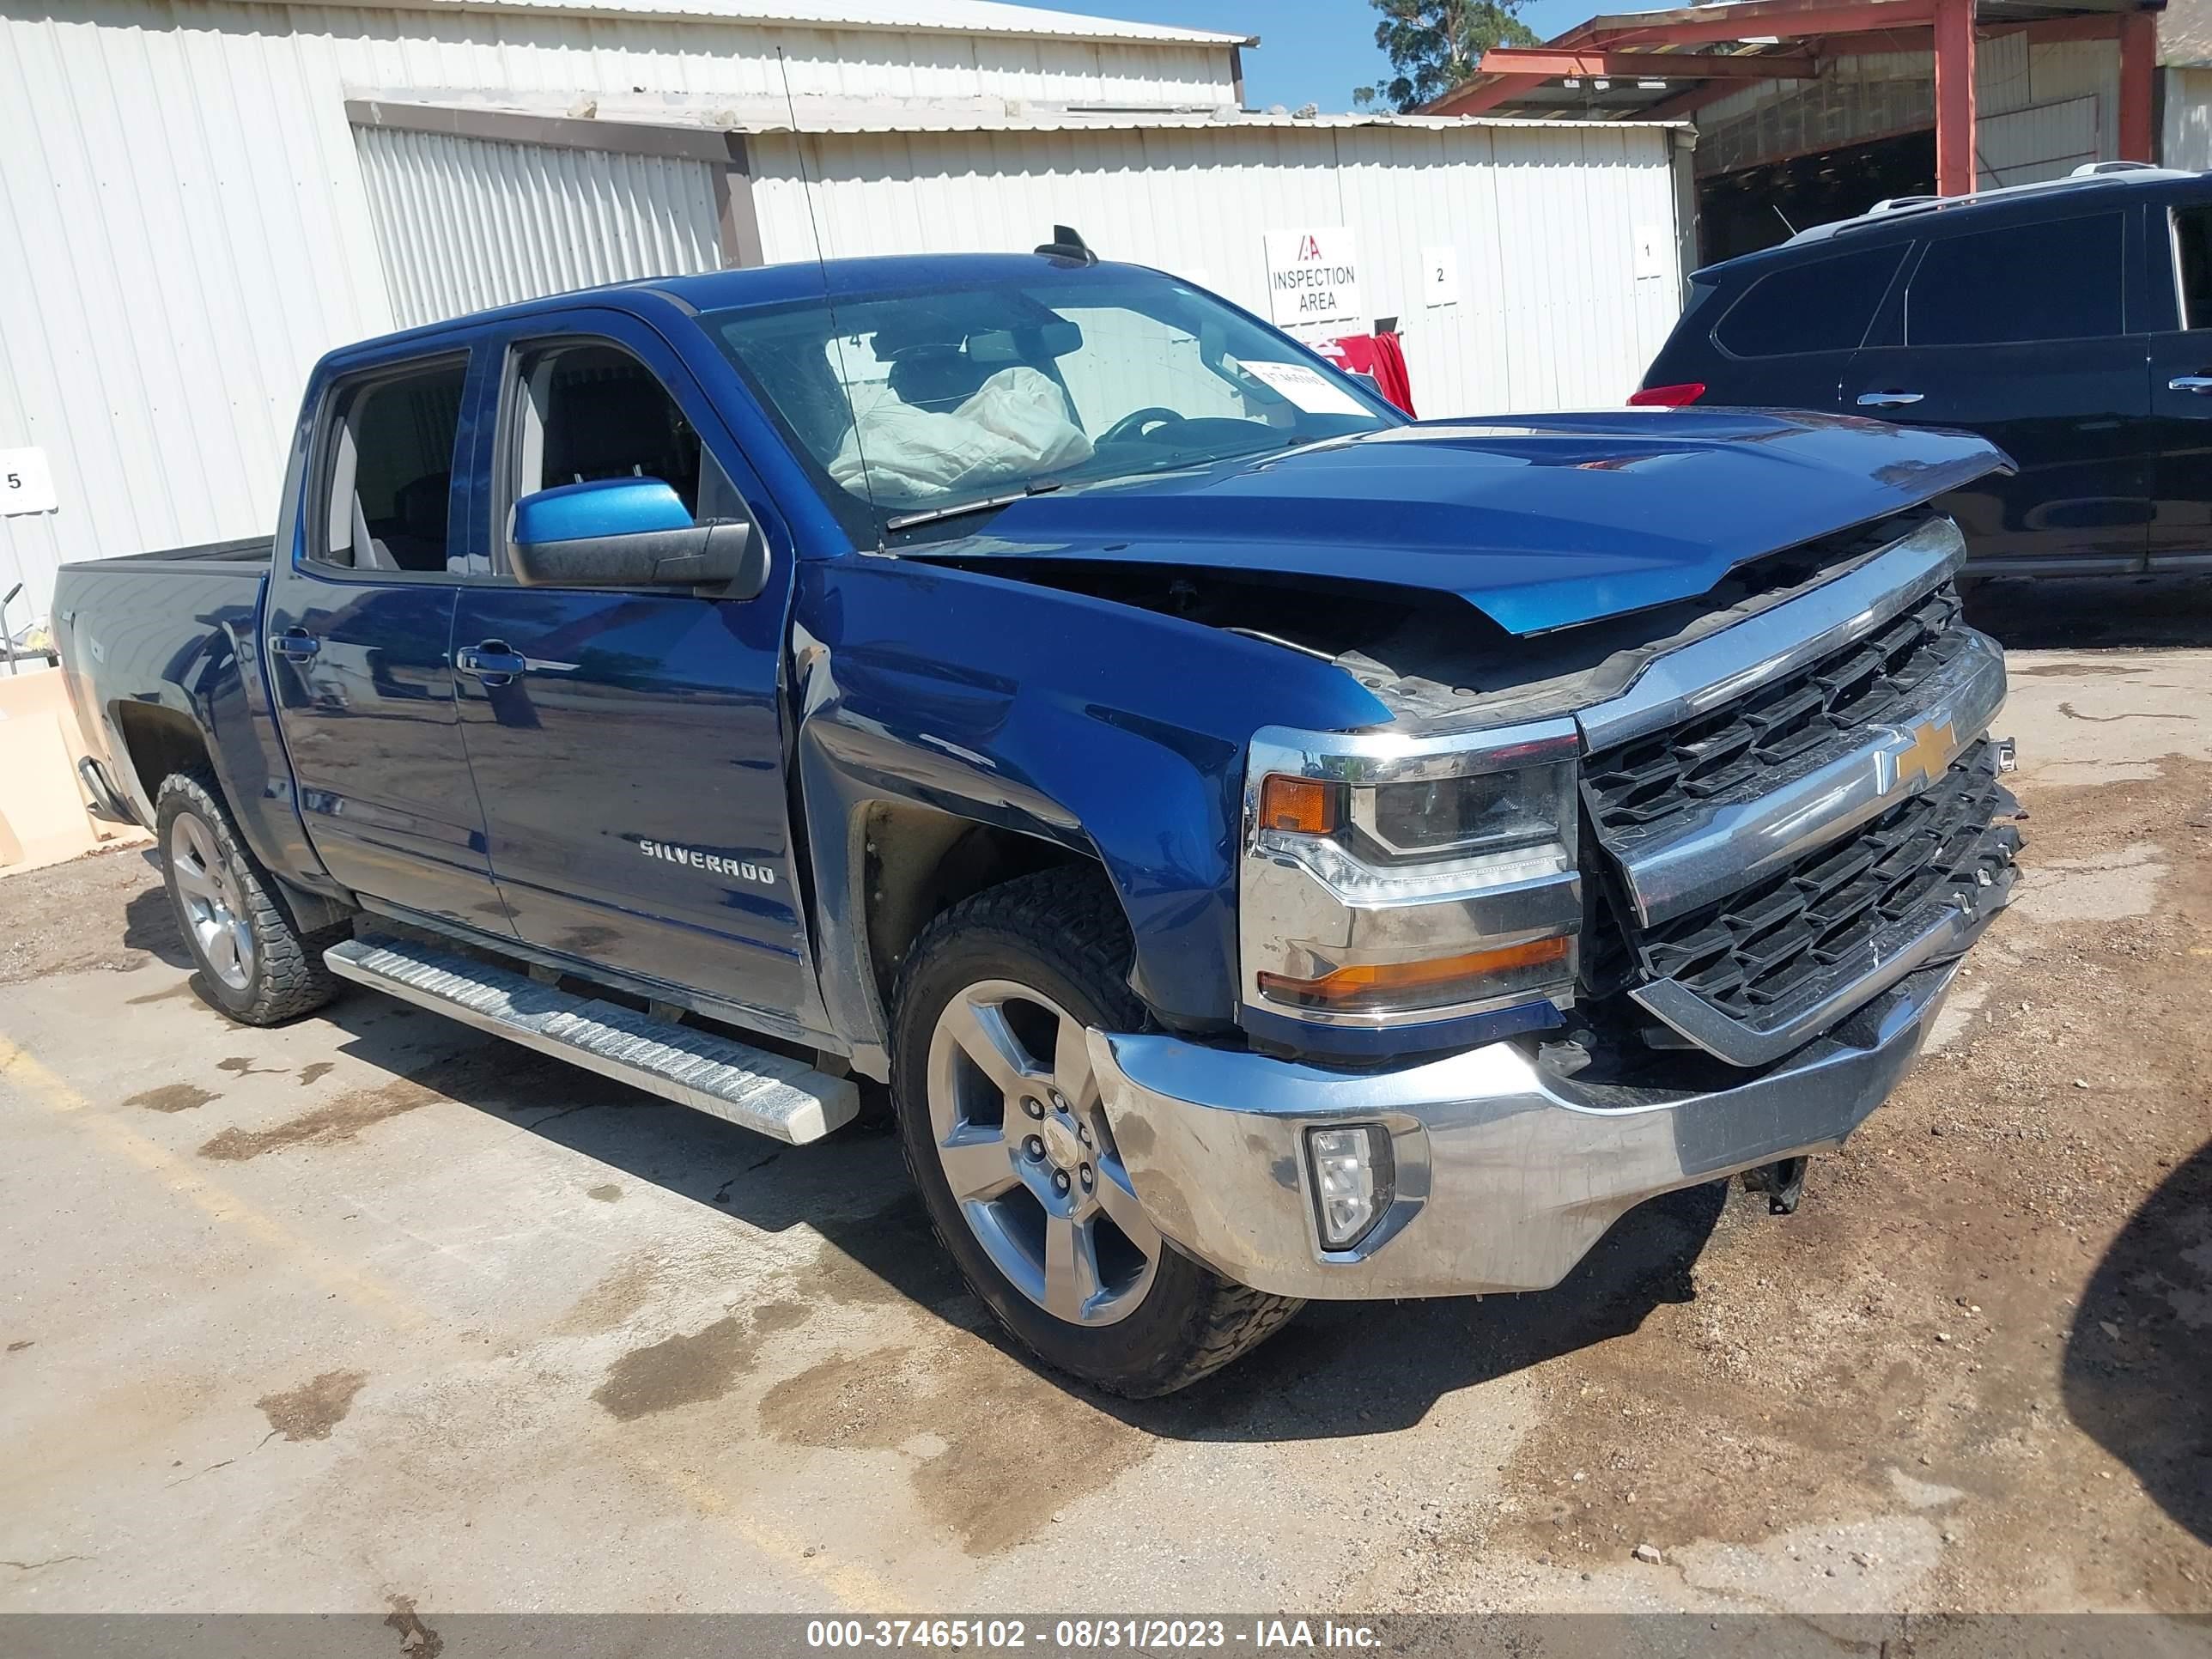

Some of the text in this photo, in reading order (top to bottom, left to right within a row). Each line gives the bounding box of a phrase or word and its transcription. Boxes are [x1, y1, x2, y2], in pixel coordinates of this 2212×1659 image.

[1644, 244, 1651, 257] 1
[1273, 265, 1355, 290] INSPECTION
[1436, 268, 1445, 283] 2
[1299, 291, 1337, 312] AREA
[7, 473, 21, 489] 5
[639, 839, 775, 885] SILVERADO
